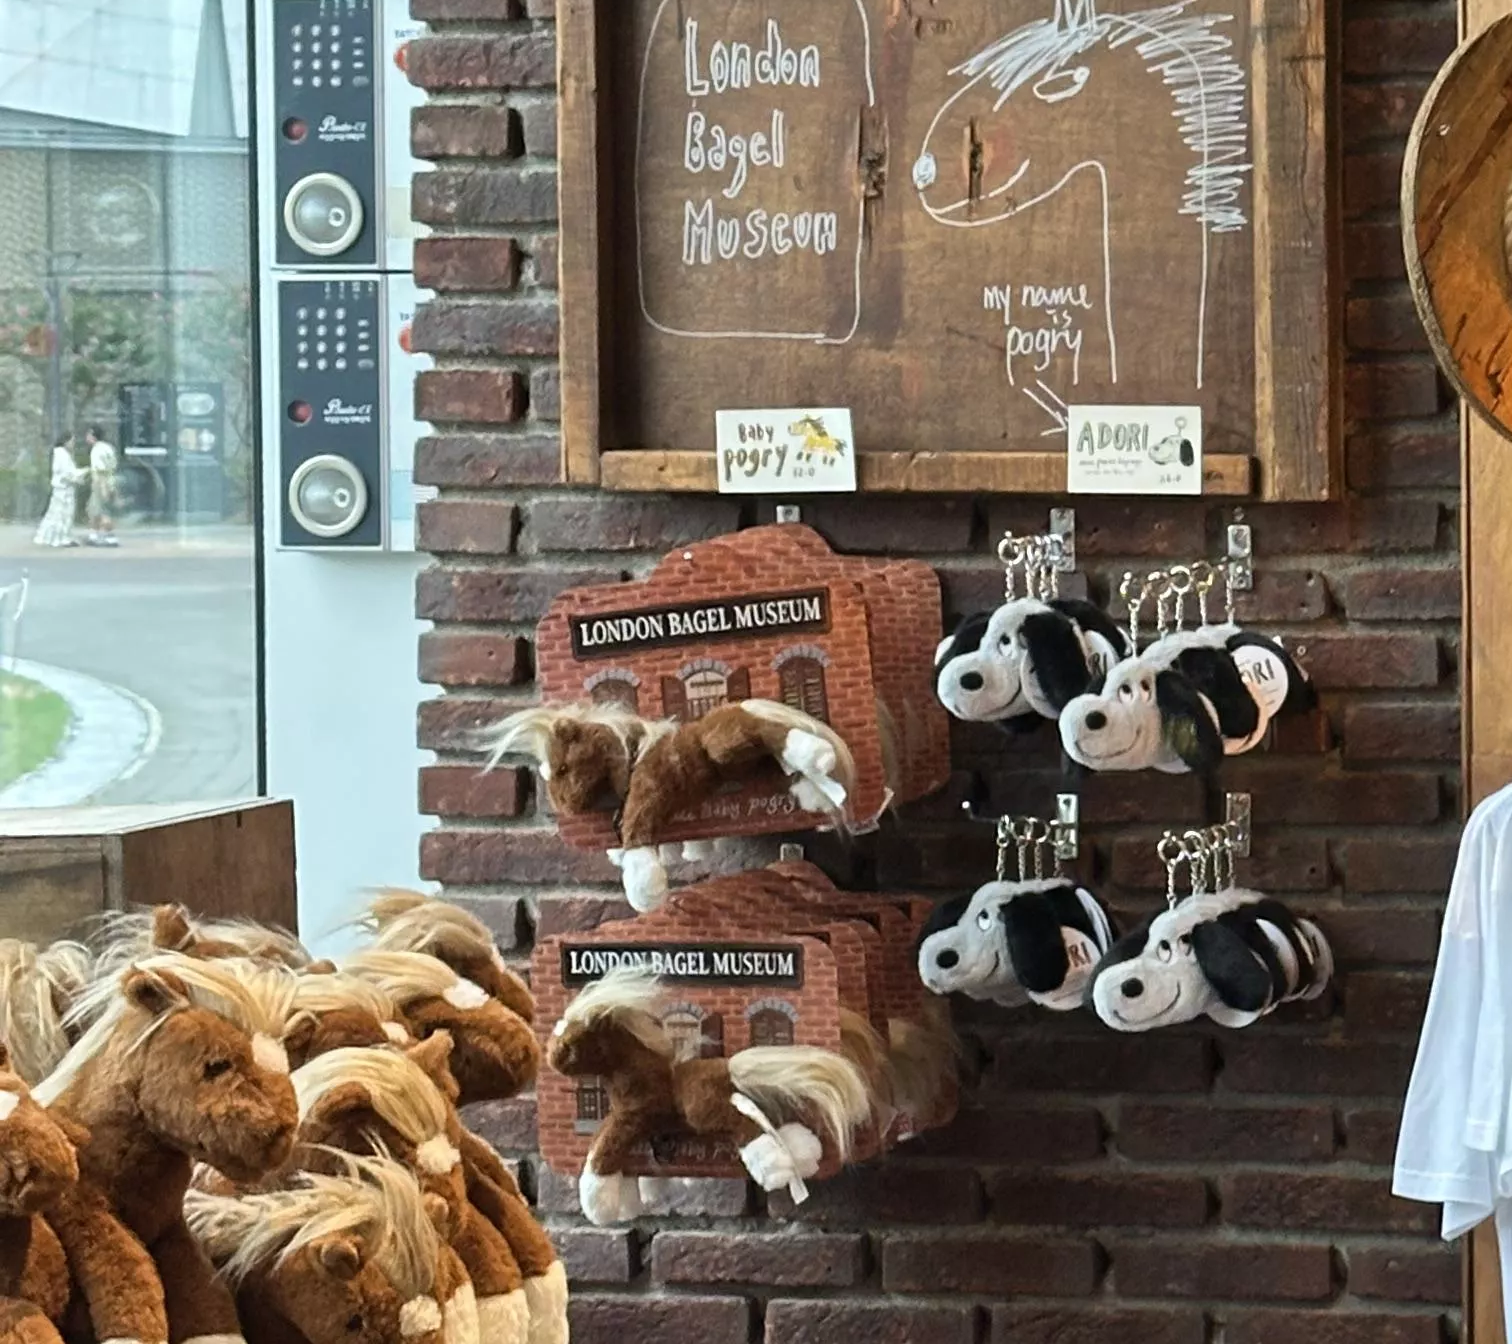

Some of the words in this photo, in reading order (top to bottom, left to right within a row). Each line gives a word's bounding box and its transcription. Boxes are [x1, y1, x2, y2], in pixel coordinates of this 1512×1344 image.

[685, 17, 820, 96] London
[685, 109, 784, 198] Bagel
[683, 198, 837, 265] Museum
[983, 284, 1011, 325] my
[1021, 284, 1093, 309] name
[1046, 309, 1072, 328] is
[1006, 326, 1082, 386] pogry
[1076, 420, 1150, 456] ADORI
[723, 444, 789, 483] pogry
[580, 616, 665, 647] LONDON
[669, 607, 732, 637] BAGEL
[734, 597, 822, 628] MUSEUM
[569, 950, 652, 975] LONDON
[651, 951, 711, 975] BAGEL
[713, 952, 795, 976] MUSEUM
